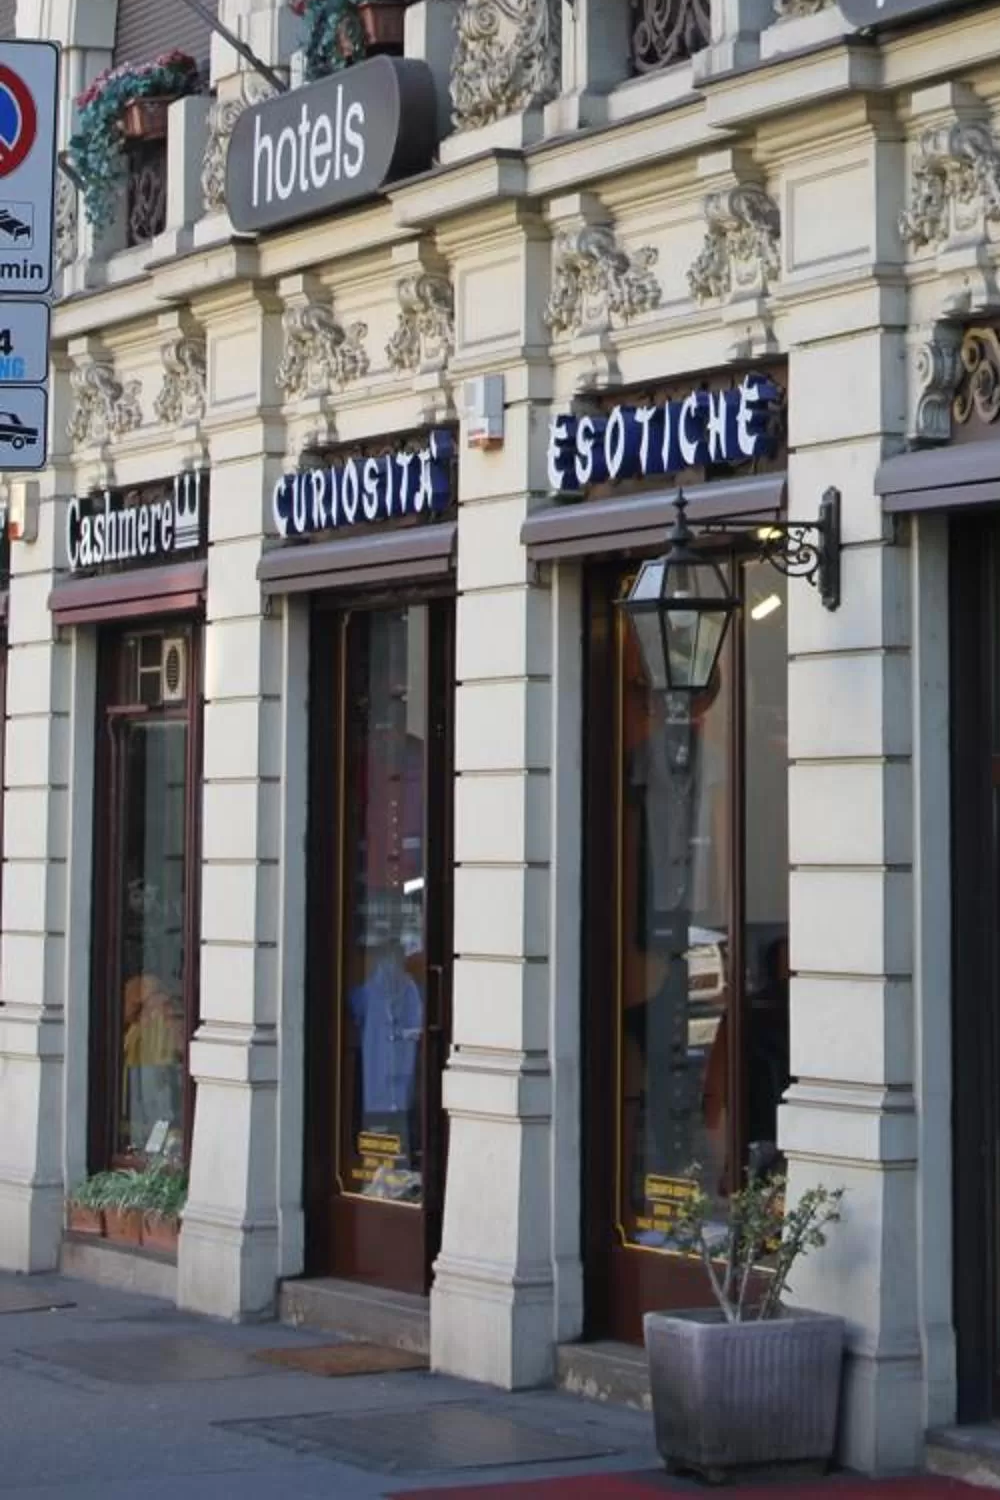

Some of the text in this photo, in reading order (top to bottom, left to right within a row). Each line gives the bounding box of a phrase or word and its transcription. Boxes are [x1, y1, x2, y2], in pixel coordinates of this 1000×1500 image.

[252, 83, 365, 207] hotels
[0, 259, 43, 279] min
[547, 374, 760, 489] ESOTICHE
